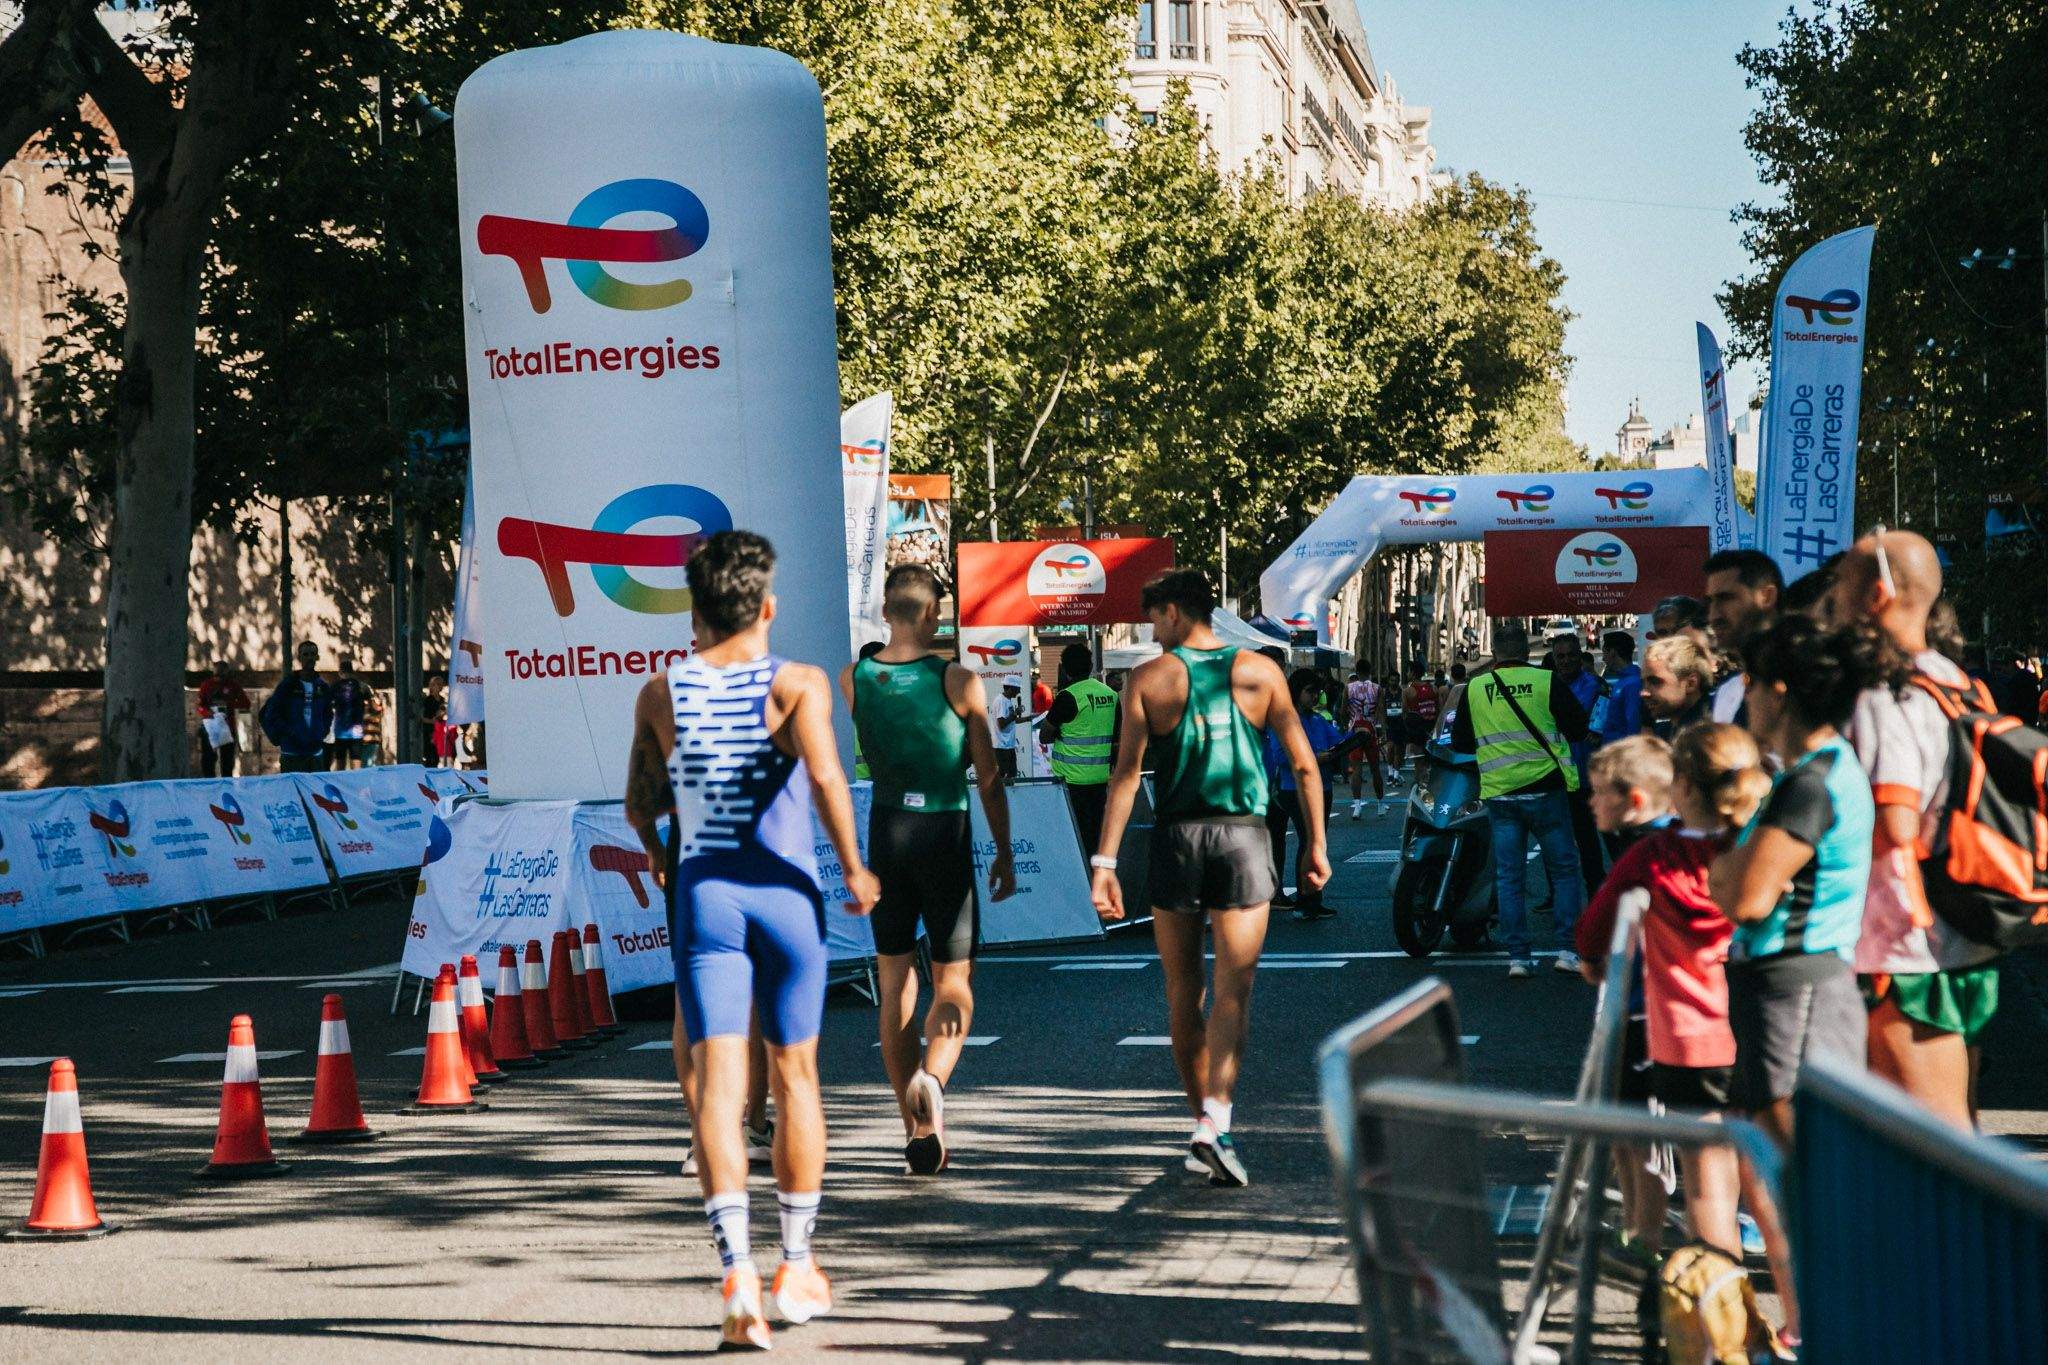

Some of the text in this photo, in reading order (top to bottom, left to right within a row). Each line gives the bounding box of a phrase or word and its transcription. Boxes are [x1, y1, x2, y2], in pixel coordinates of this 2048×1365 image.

[1784, 331, 1858, 344] TotalEnergies
[485, 337, 720, 380] TotalEnergies
[1988, 493, 2013, 503] ISLA
[1400, 518, 1457, 527] TotalEnergies
[1497, 516, 1555, 526] TotalEnergies
[1595, 514, 1654, 524] TotalEnergies
[1574, 570, 1622, 578] TotalEnergies
[612, 926, 670, 954] TotalE
